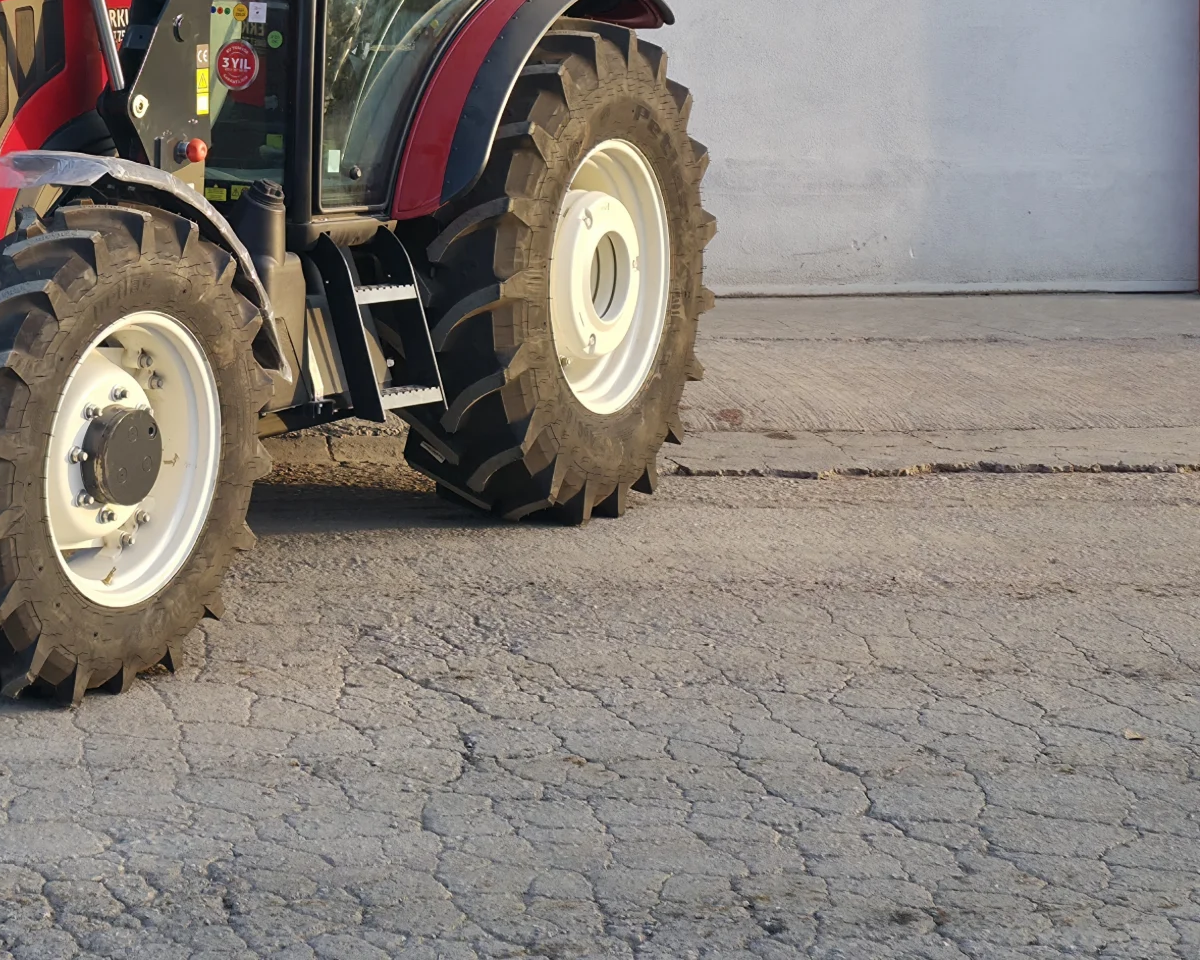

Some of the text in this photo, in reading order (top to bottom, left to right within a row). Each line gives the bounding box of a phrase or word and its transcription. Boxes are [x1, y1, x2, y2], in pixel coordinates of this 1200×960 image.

[197, 49, 208, 63] CE
[221, 57, 251, 70] 3 YIL
